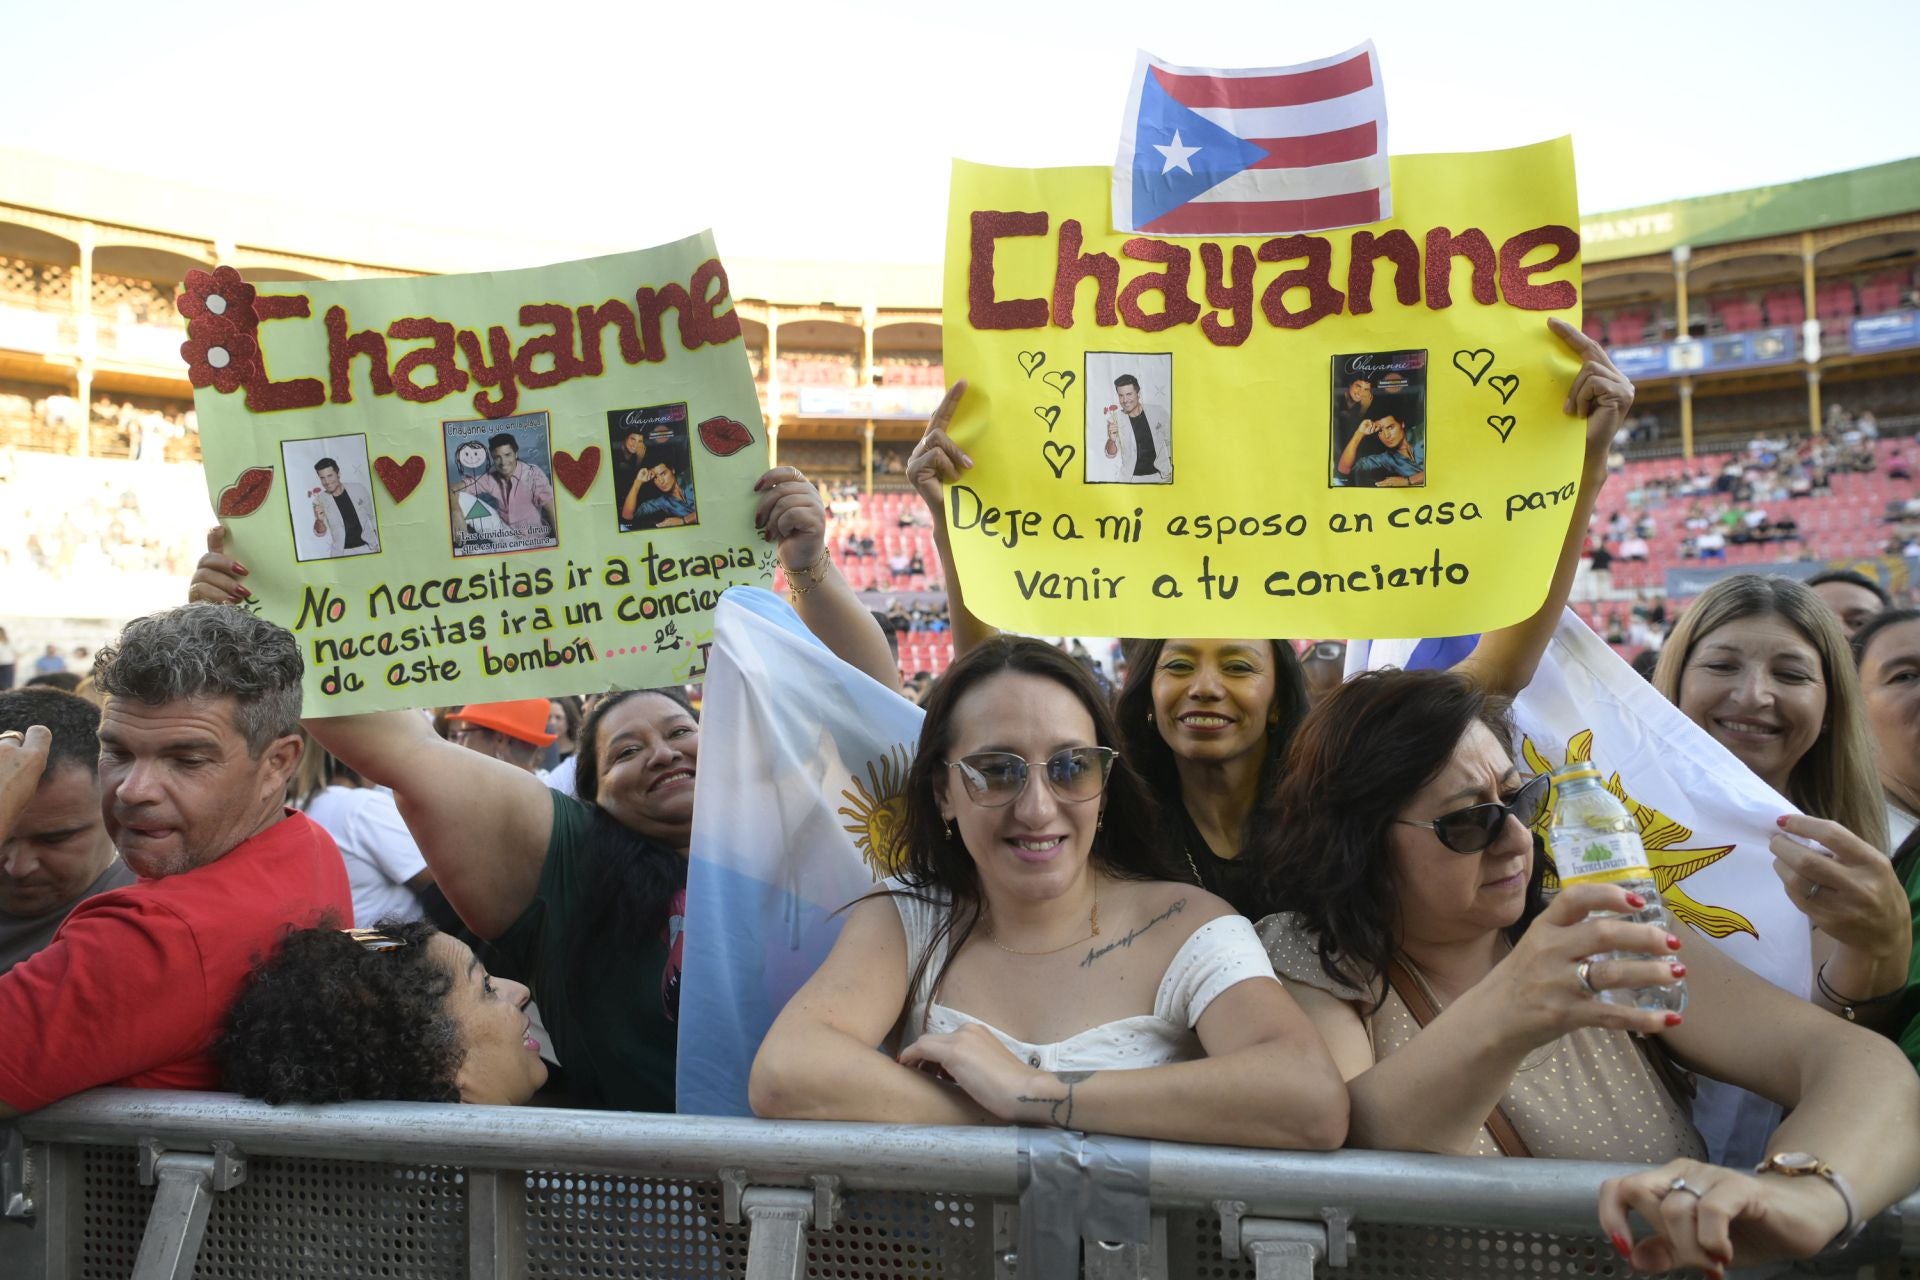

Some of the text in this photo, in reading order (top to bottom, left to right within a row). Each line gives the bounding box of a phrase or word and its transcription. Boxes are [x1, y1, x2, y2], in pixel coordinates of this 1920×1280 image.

[968, 210, 1580, 347] Chayanne
[243, 258, 742, 420] Chayanne
[1344, 354, 1408, 379] Chayanne
[447, 424, 486, 439] Chayanne
[619, 409, 672, 431] Chayanne
[1052, 513, 1084, 540] a
[1096, 507, 1143, 543] mi
[1166, 513, 1307, 545] esposo
[1387, 501, 1483, 528] casa
[1505, 481, 1576, 522] para
[295, 541, 756, 630] No necesitas ir a terapia
[1015, 548, 1469, 601] venir a tu concierto
[314, 614, 487, 664] necesitas
[564, 600, 602, 626] un
[617, 580, 750, 622] concier
[386, 655, 461, 686] este
